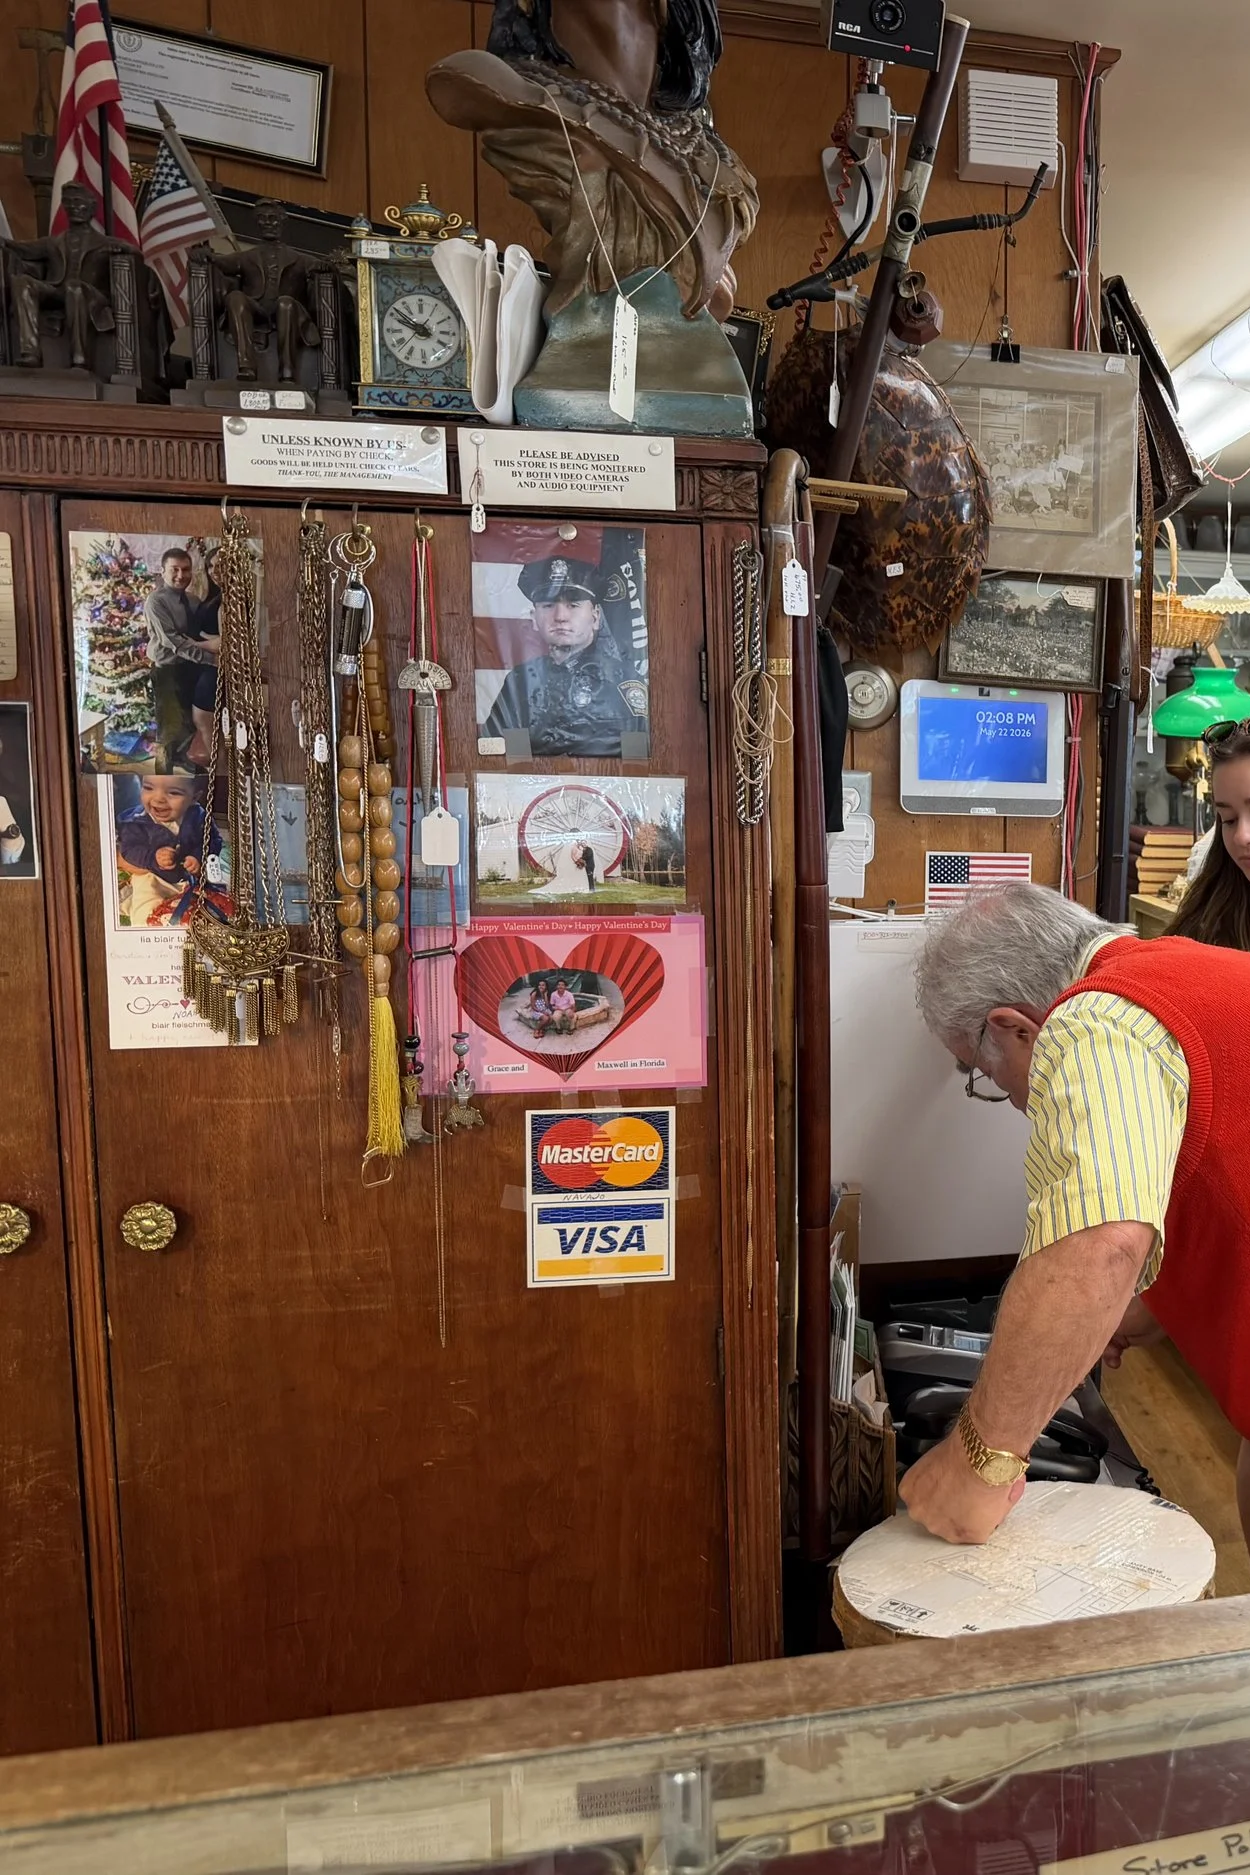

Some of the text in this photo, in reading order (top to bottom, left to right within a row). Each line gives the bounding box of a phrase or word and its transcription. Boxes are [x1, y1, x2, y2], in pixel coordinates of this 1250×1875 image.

[838, 21, 861, 33] RCA
[261, 434, 311, 446] UNLESS
[314, 436, 363, 448] KNOWN
[366, 438, 383, 449] BY
[276, 447, 305, 457] WHEN
[306, 449, 342, 459] PAYING
[344, 450, 357, 459] BY
[519, 449, 620, 462] PLEASE BE ADVISED
[250, 458, 278, 467] GOODS
[279, 459, 300, 467] WILL
[300, 460, 312, 468] BE
[334, 462, 358, 470] UNTIL
[359, 463, 386, 471] CHECK
[493, 459, 515, 468] THIS
[516, 460, 548, 469] STORE
[560, 462, 589, 472] BEING
[590, 464, 646, 474] MONITERED
[323, 470, 338, 478] THE
[511, 470, 630, 483] BY BOTH VIDEO CAMERAS
[516, 481, 625, 493] AND AUDIO EQUIPMENT
[975, 711, 1036, 725] 02:08 PM
[980, 727, 1032, 738] May 22 2026
[471, 919, 668, 933] Happy Valentine's Day Happy Valentine's Day
[140, 935, 175, 943] lia blair
[486, 1063, 525, 1073] Grace and
[596, 1058, 666, 1070] Maxwell in Florida
[540, 1142, 661, 1165] MasterCard
[553, 1224, 647, 1255] VISA
[1122, 1852, 1209, 1875] Store
